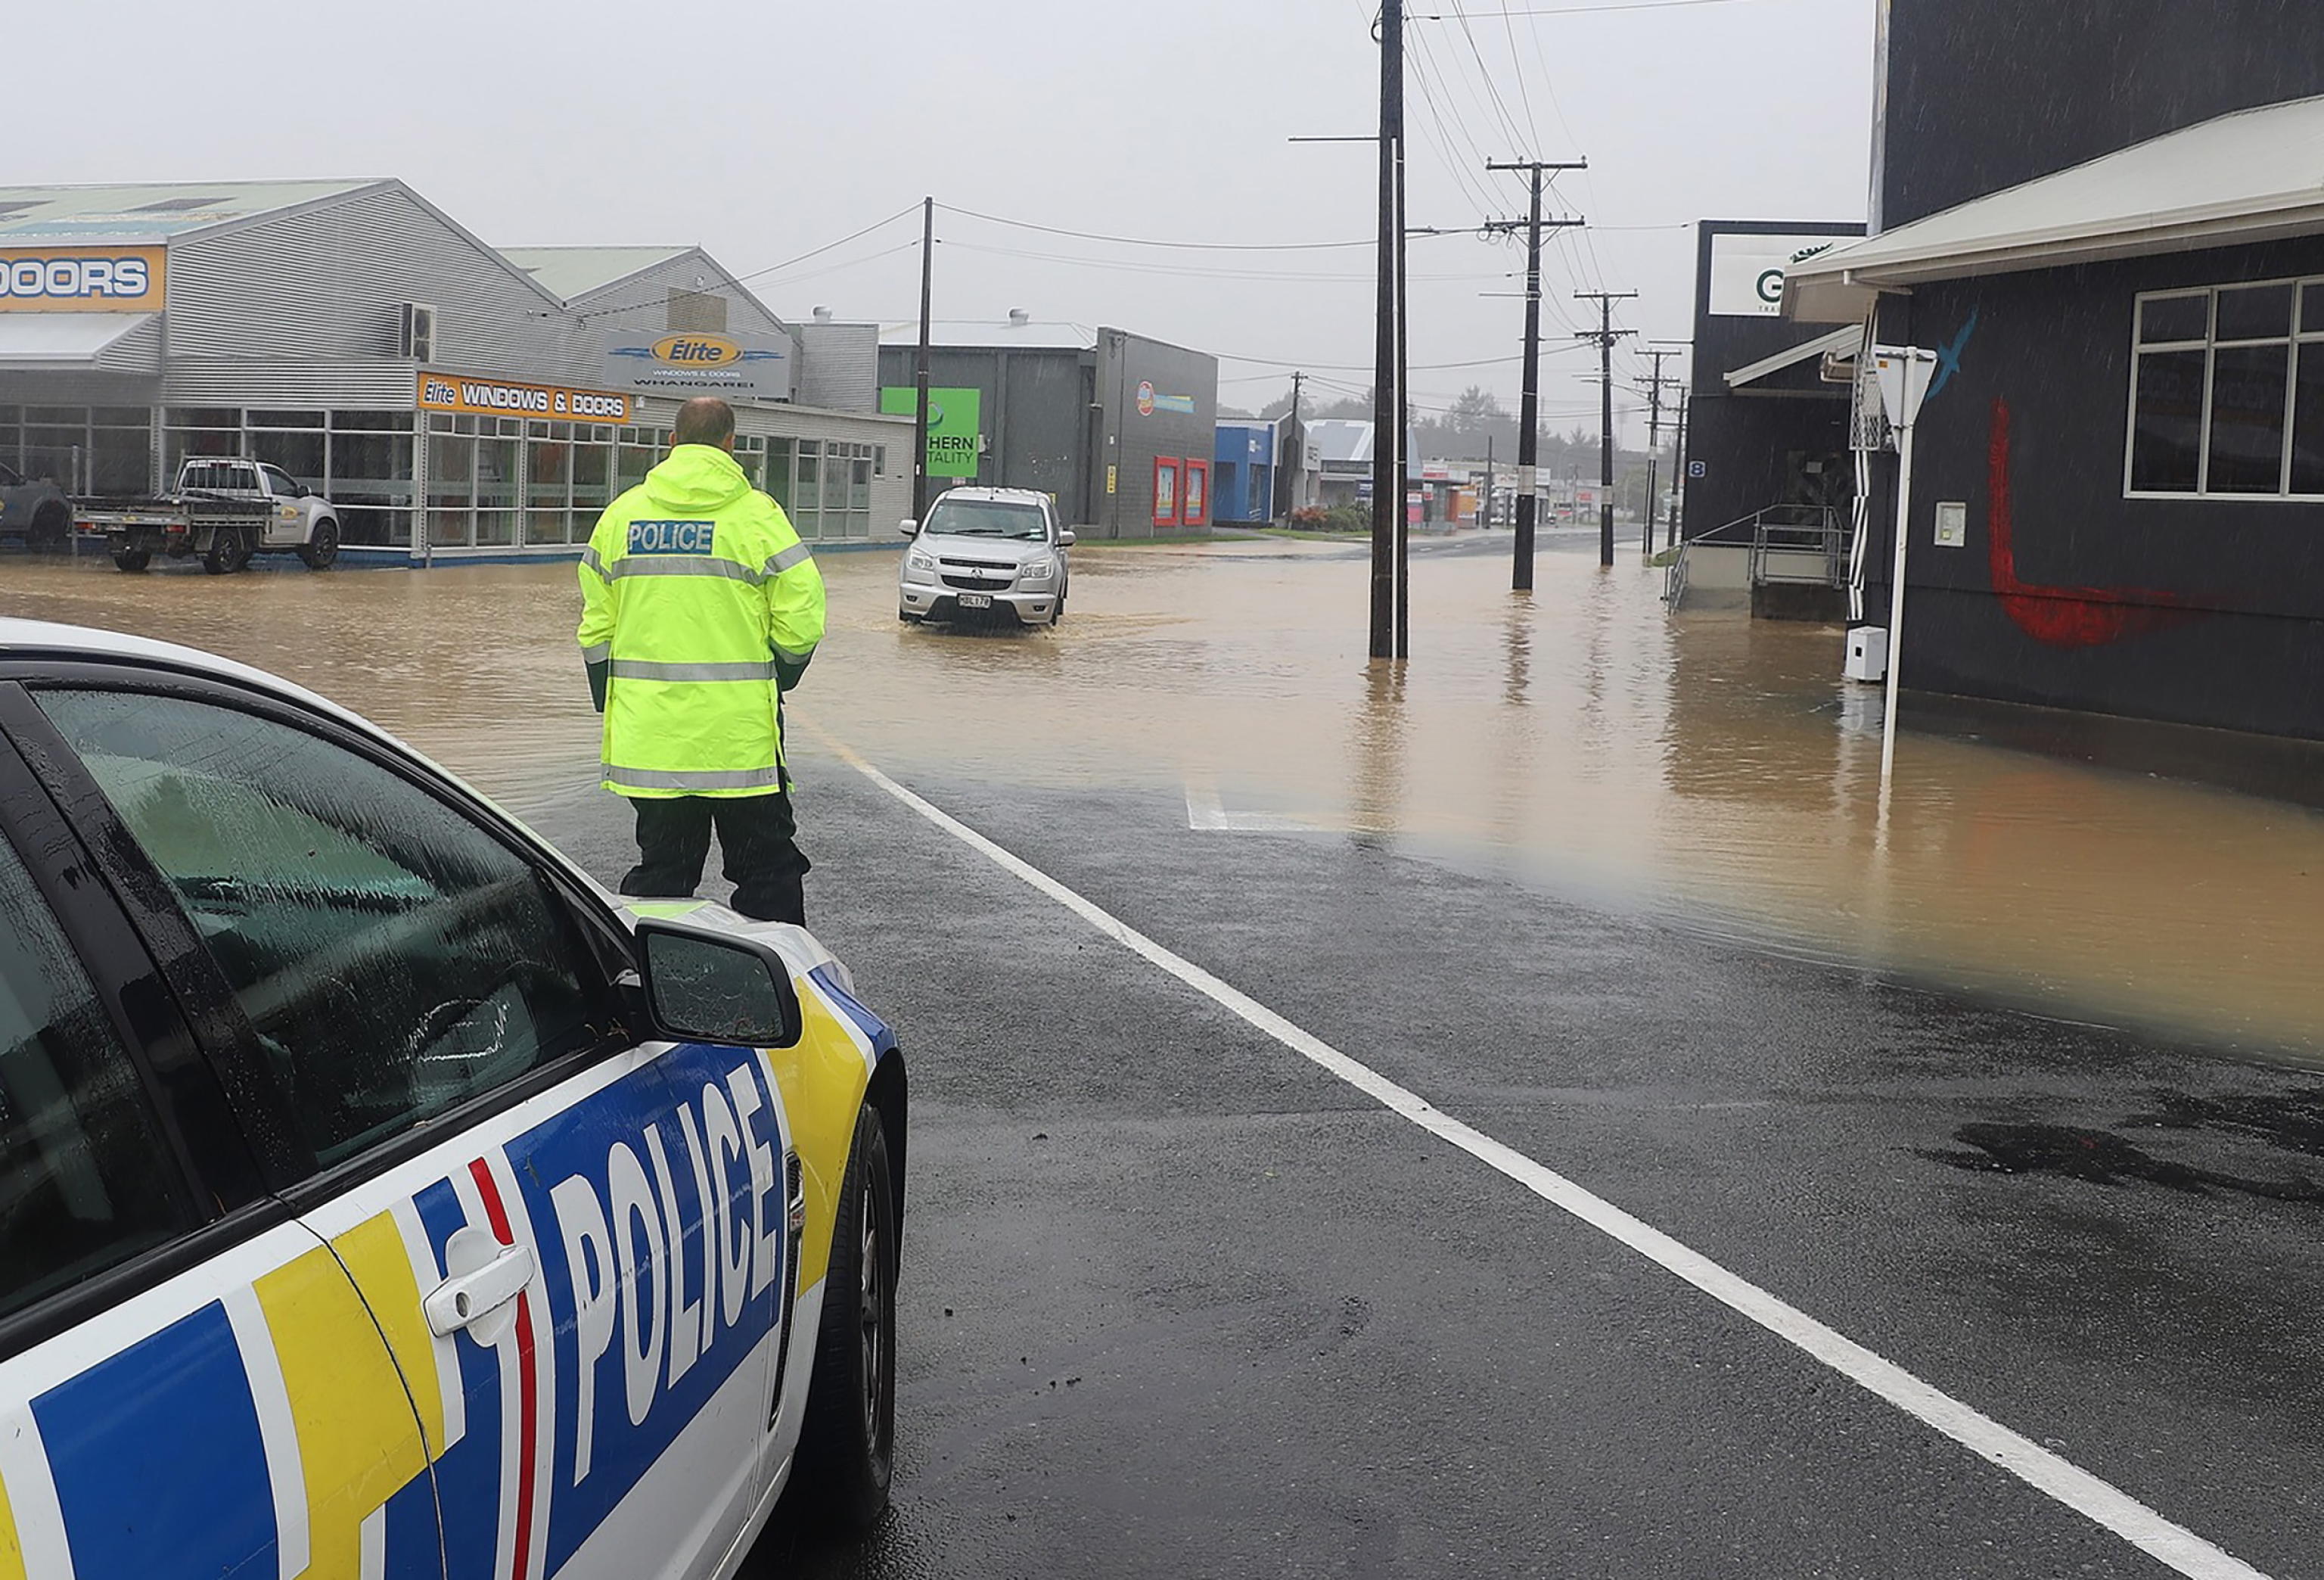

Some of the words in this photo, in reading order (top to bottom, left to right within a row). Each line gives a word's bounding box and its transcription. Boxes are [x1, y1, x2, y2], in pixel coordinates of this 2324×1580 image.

[0, 258, 148, 297] OORS
[634, 379, 754, 388] WHANGAREI
[461, 382, 548, 411] WINDOWS
[554, 391, 567, 412] &
[572, 393, 625, 416] DOORS
[929, 437, 974, 449] HERN
[927, 450, 973, 463] TALITY
[1692, 462, 1704, 475] 8
[629, 523, 713, 550] POLICE
[549, 1063, 777, 1486] POLICE
